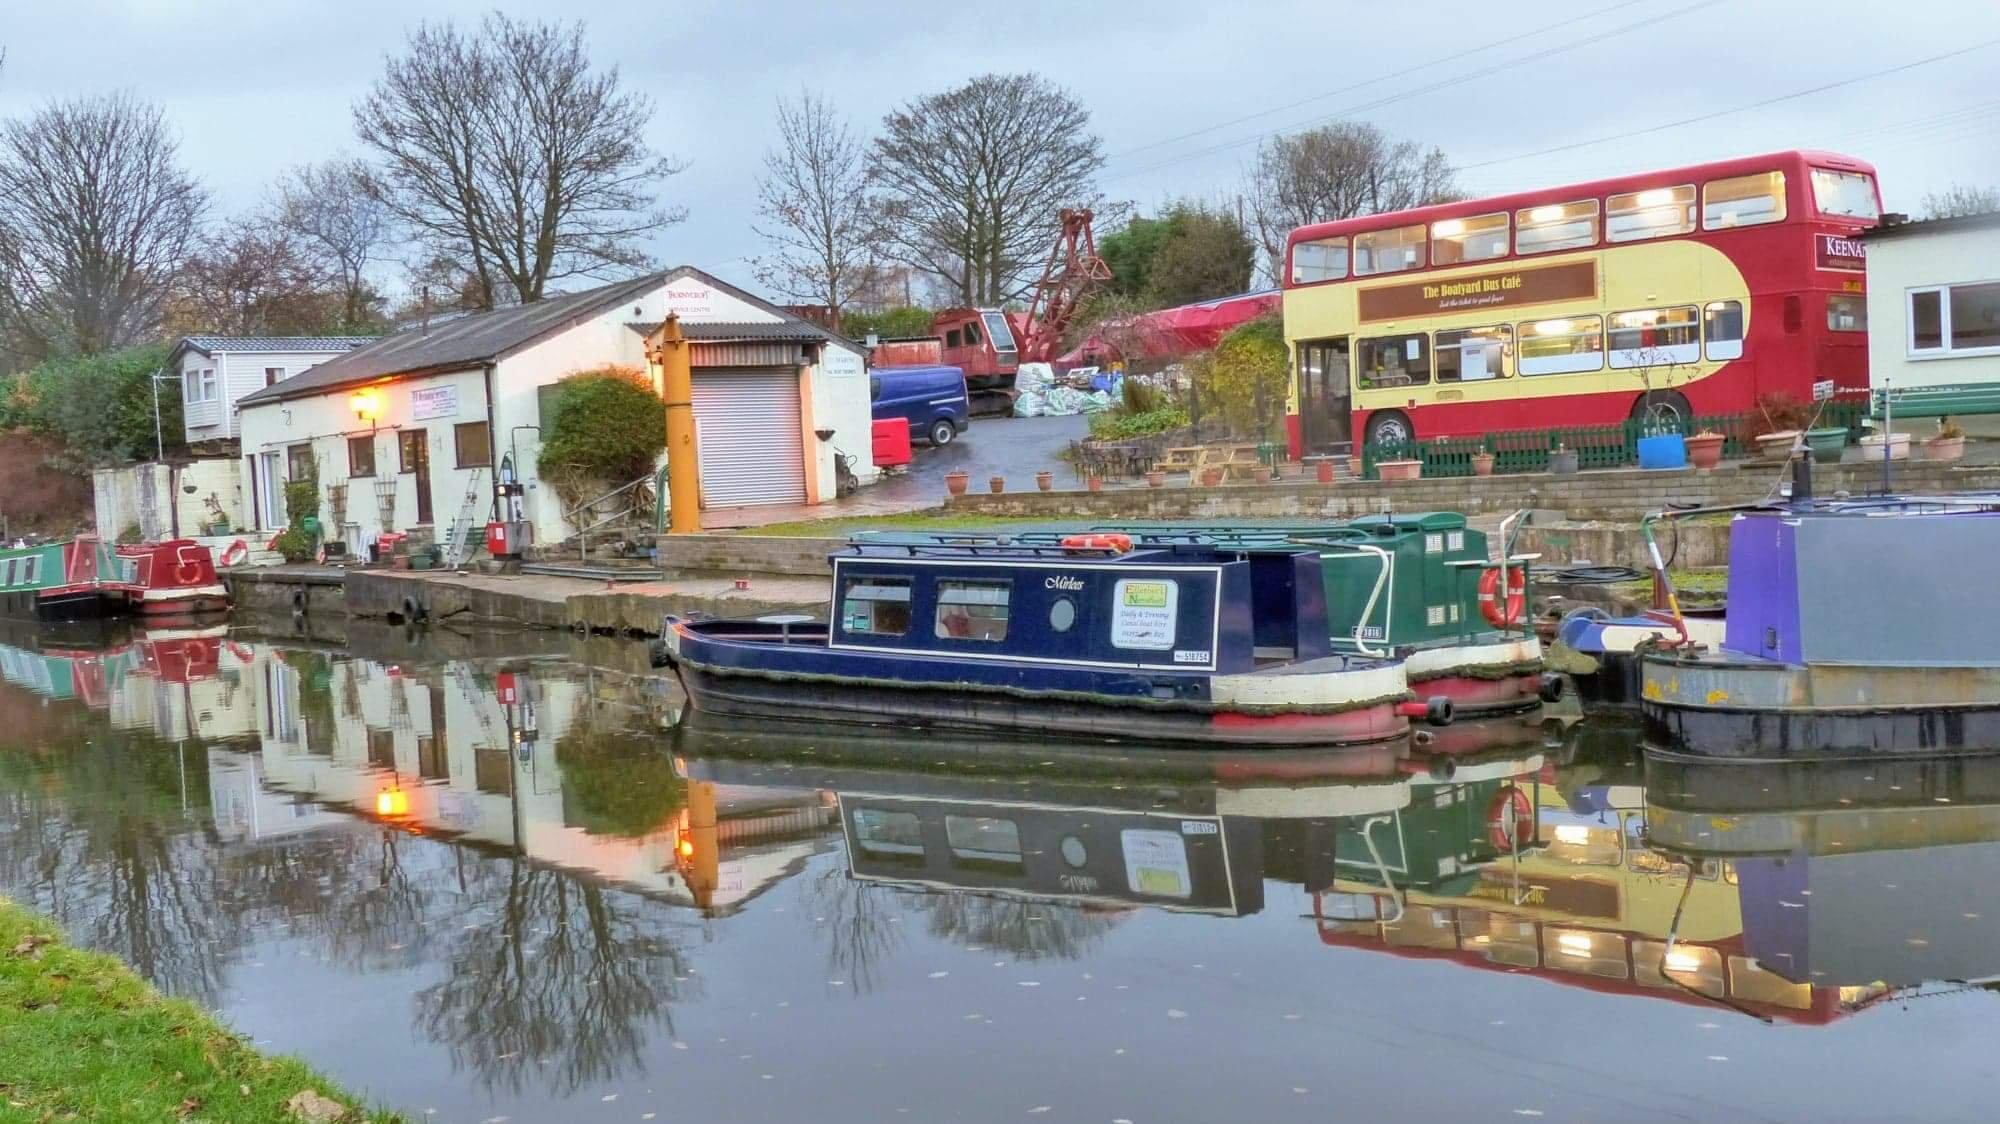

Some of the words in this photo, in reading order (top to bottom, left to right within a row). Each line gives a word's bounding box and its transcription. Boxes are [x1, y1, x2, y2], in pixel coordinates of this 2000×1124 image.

[1423, 286, 1440, 299] The
[1441, 280, 1481, 297] Boatyard
[1483, 279, 1500, 292] Bus
[1502, 274, 1522, 290] Café
